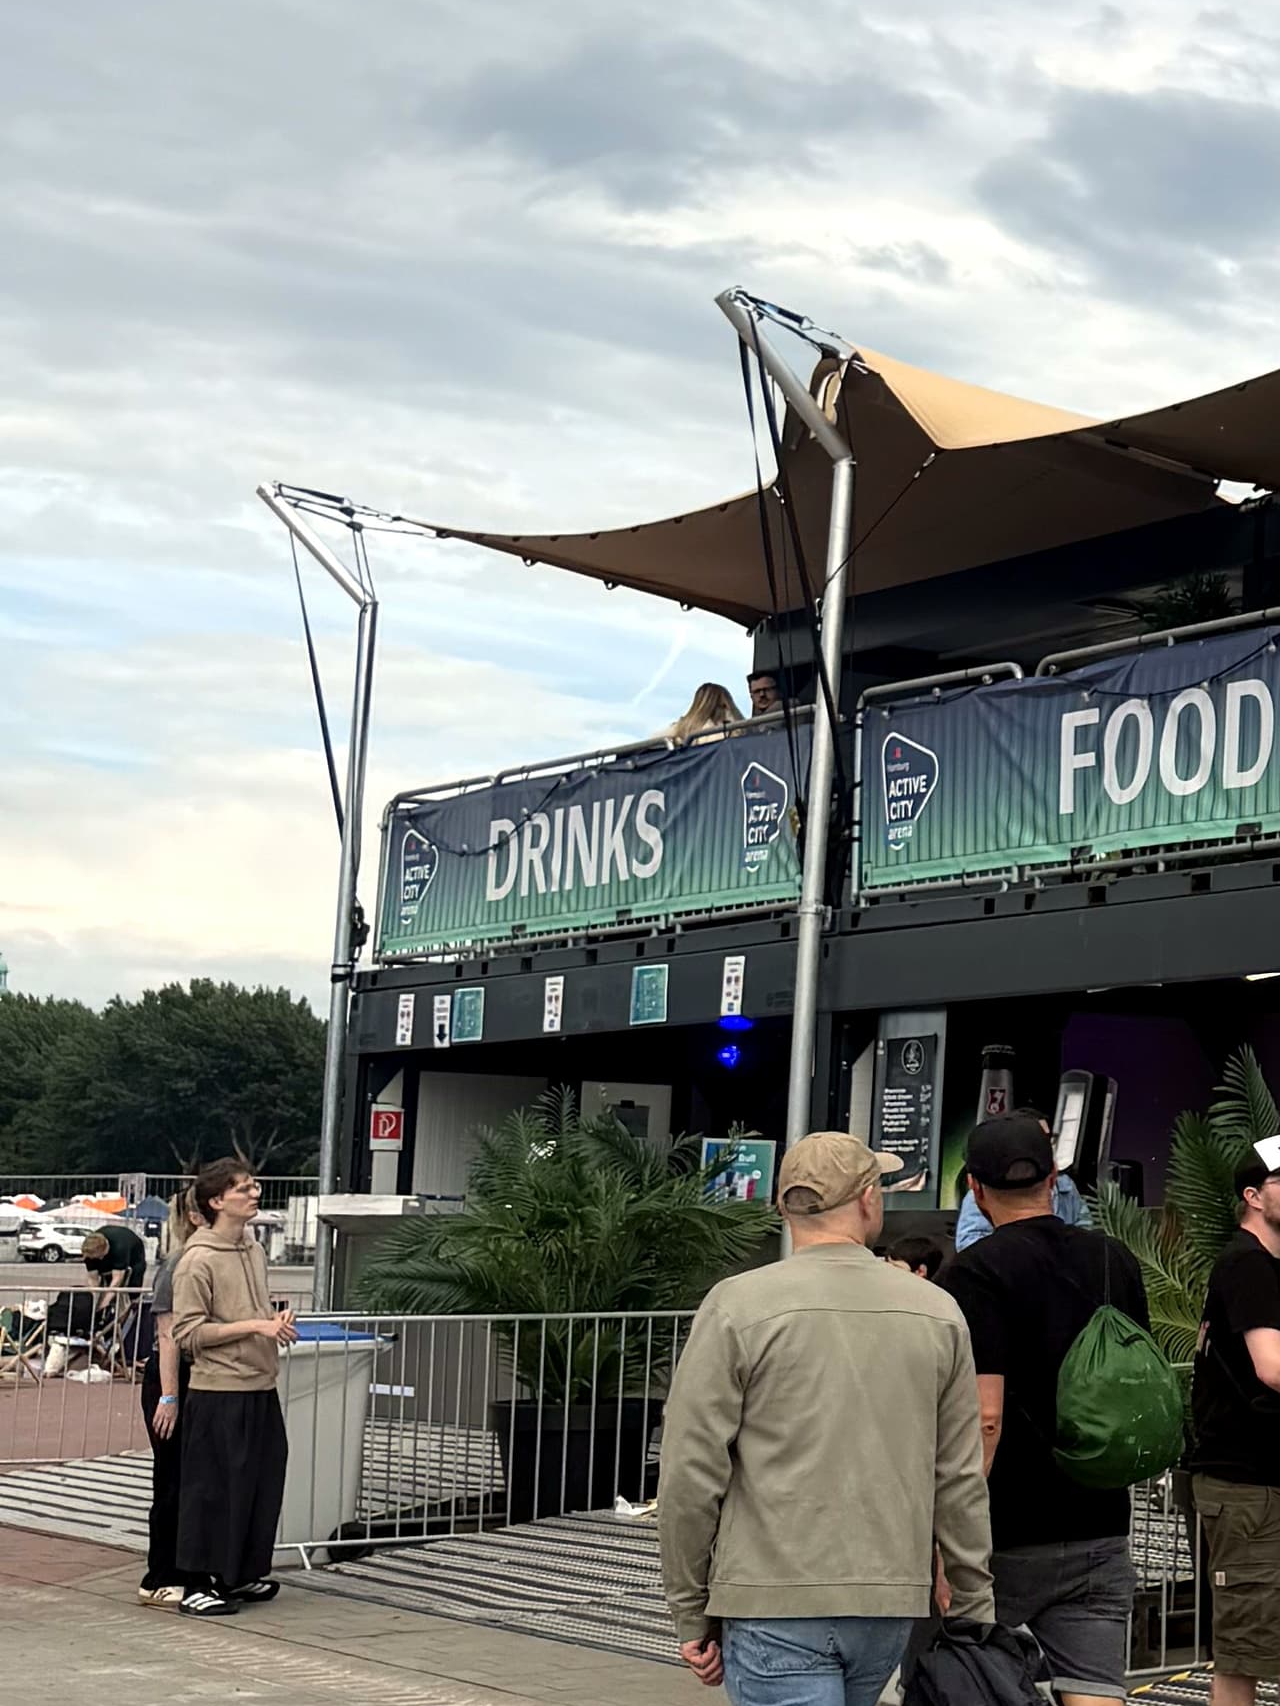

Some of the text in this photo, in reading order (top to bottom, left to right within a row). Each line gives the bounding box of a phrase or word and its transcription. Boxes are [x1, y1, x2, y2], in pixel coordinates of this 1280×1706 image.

[1059, 678, 1276, 815] FOOD
[888, 774, 928, 799] ACTIVE
[890, 799, 914, 820] CITY
[485, 788, 666, 902] DRINKS
